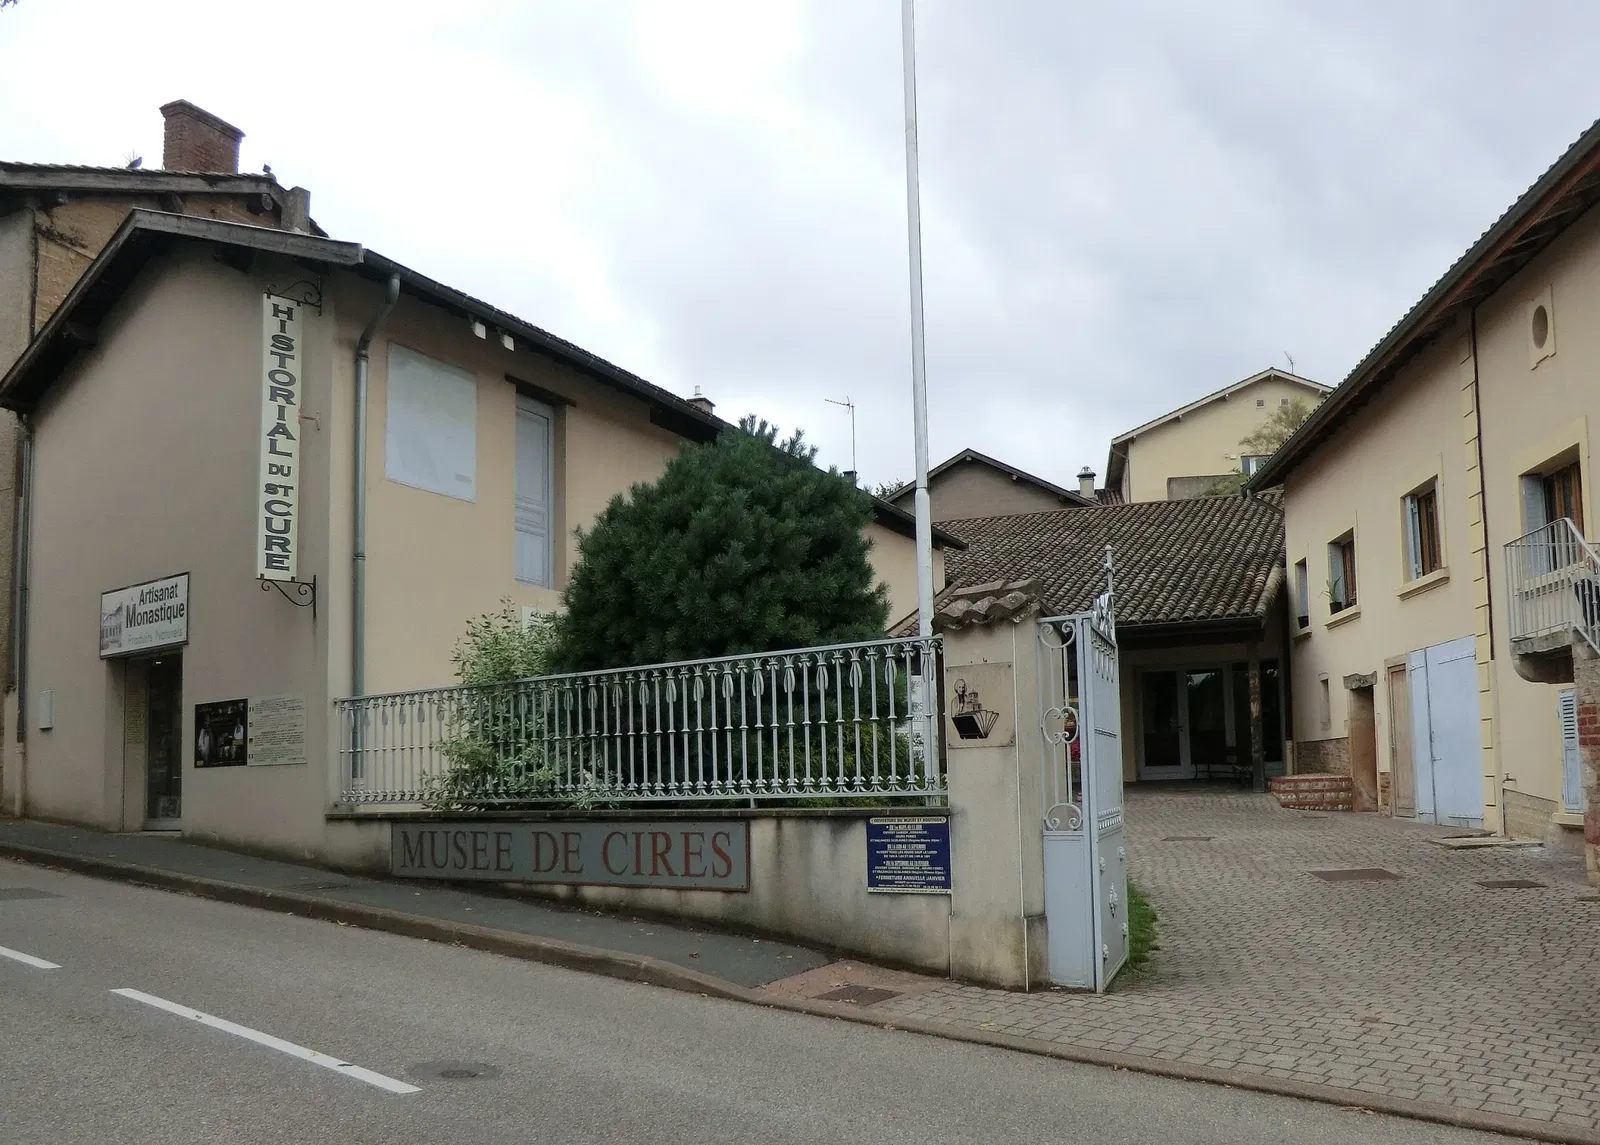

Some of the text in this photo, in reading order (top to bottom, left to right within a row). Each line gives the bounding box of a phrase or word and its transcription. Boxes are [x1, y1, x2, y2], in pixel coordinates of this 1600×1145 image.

[264, 303, 297, 571] HISTORIAL DU ST CURE
[139, 583, 178, 606] Artisanat
[126, 602, 185, 628] Monastique
[400, 831, 734, 878] MUSEE DE CIRES
